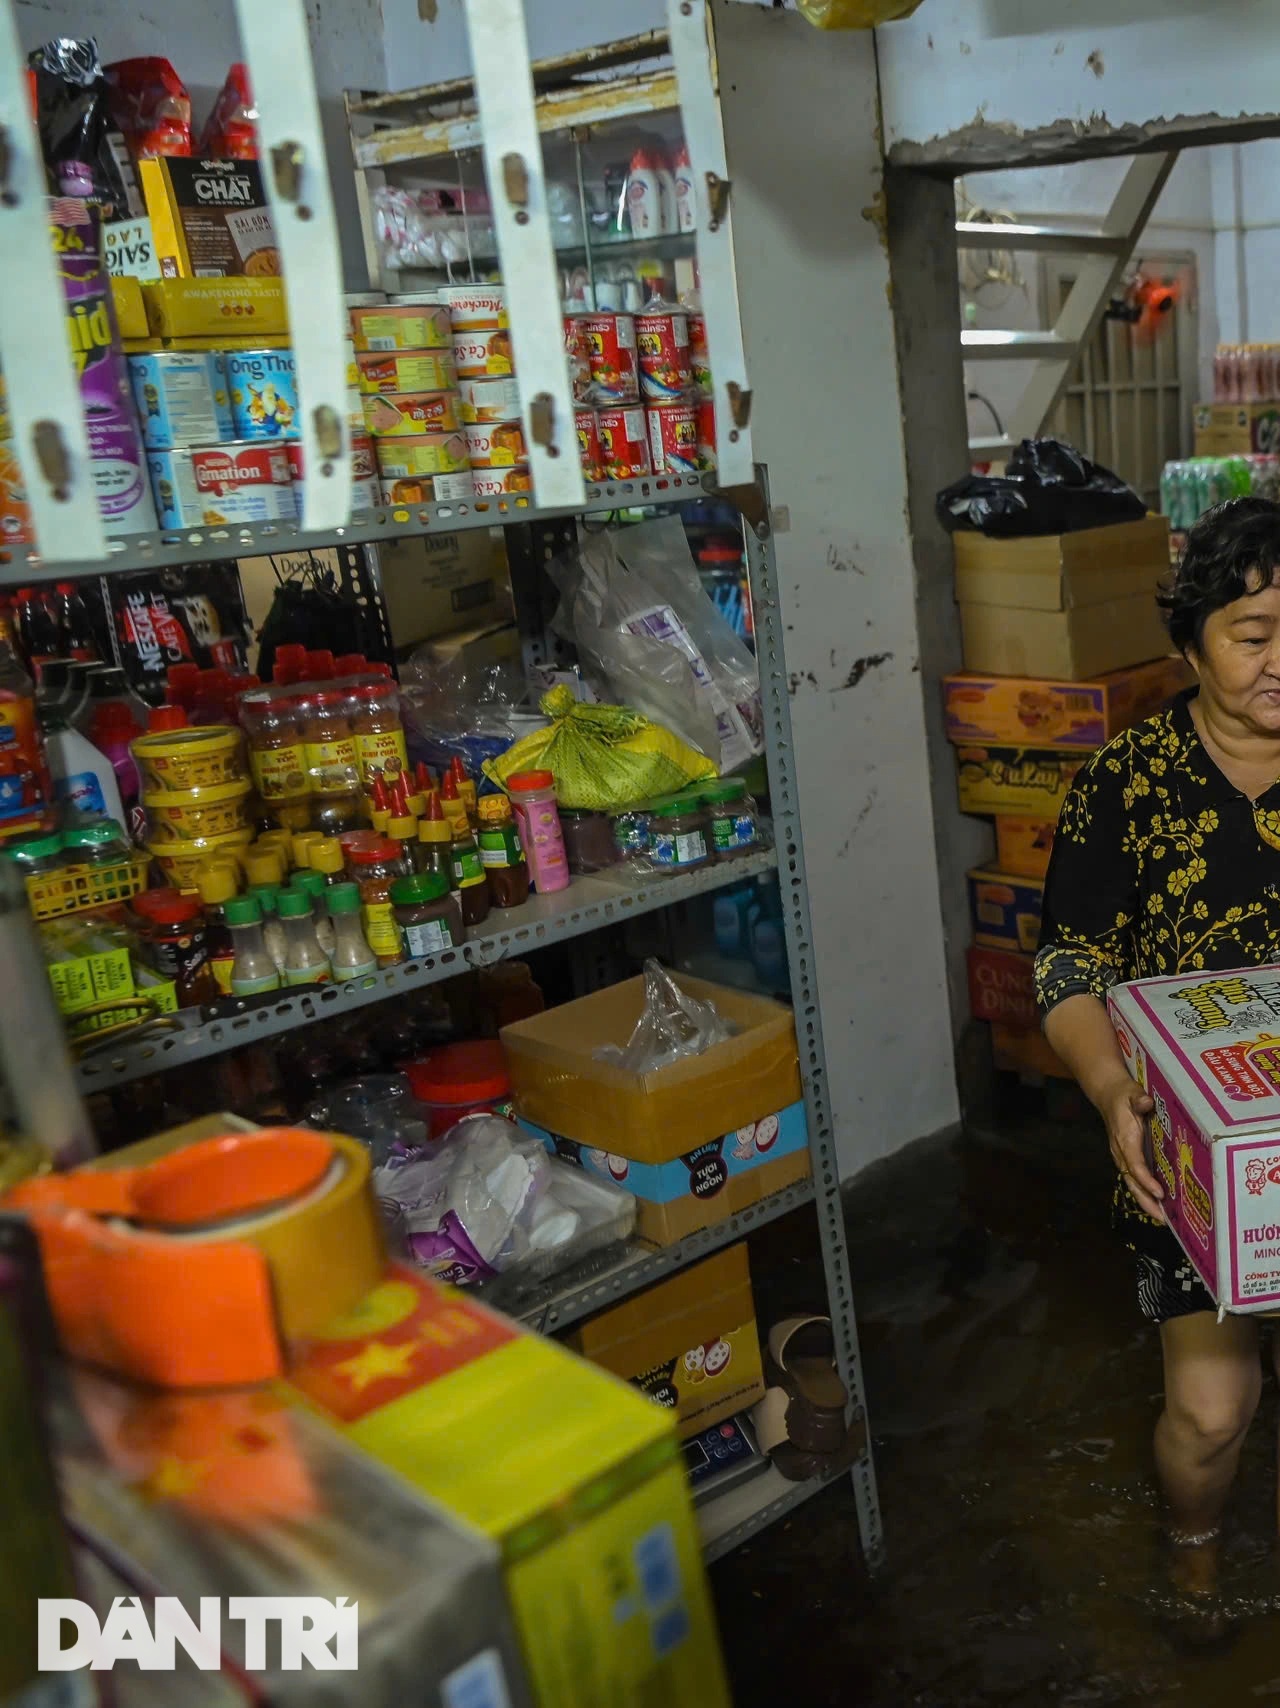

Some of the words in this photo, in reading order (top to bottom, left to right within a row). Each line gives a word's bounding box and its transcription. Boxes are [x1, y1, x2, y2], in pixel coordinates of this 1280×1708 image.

[183, 288, 251, 298] AWAKENING
[196, 464, 260, 487] Carnation
[1228, 1057, 1247, 1071] SUNG
[1215, 1065, 1237, 1084] XANH
[696, 1161, 718, 1179] TƯƠI
[695, 1174, 723, 1194] NGON
[1245, 1272, 1268, 1281] CÔNG
